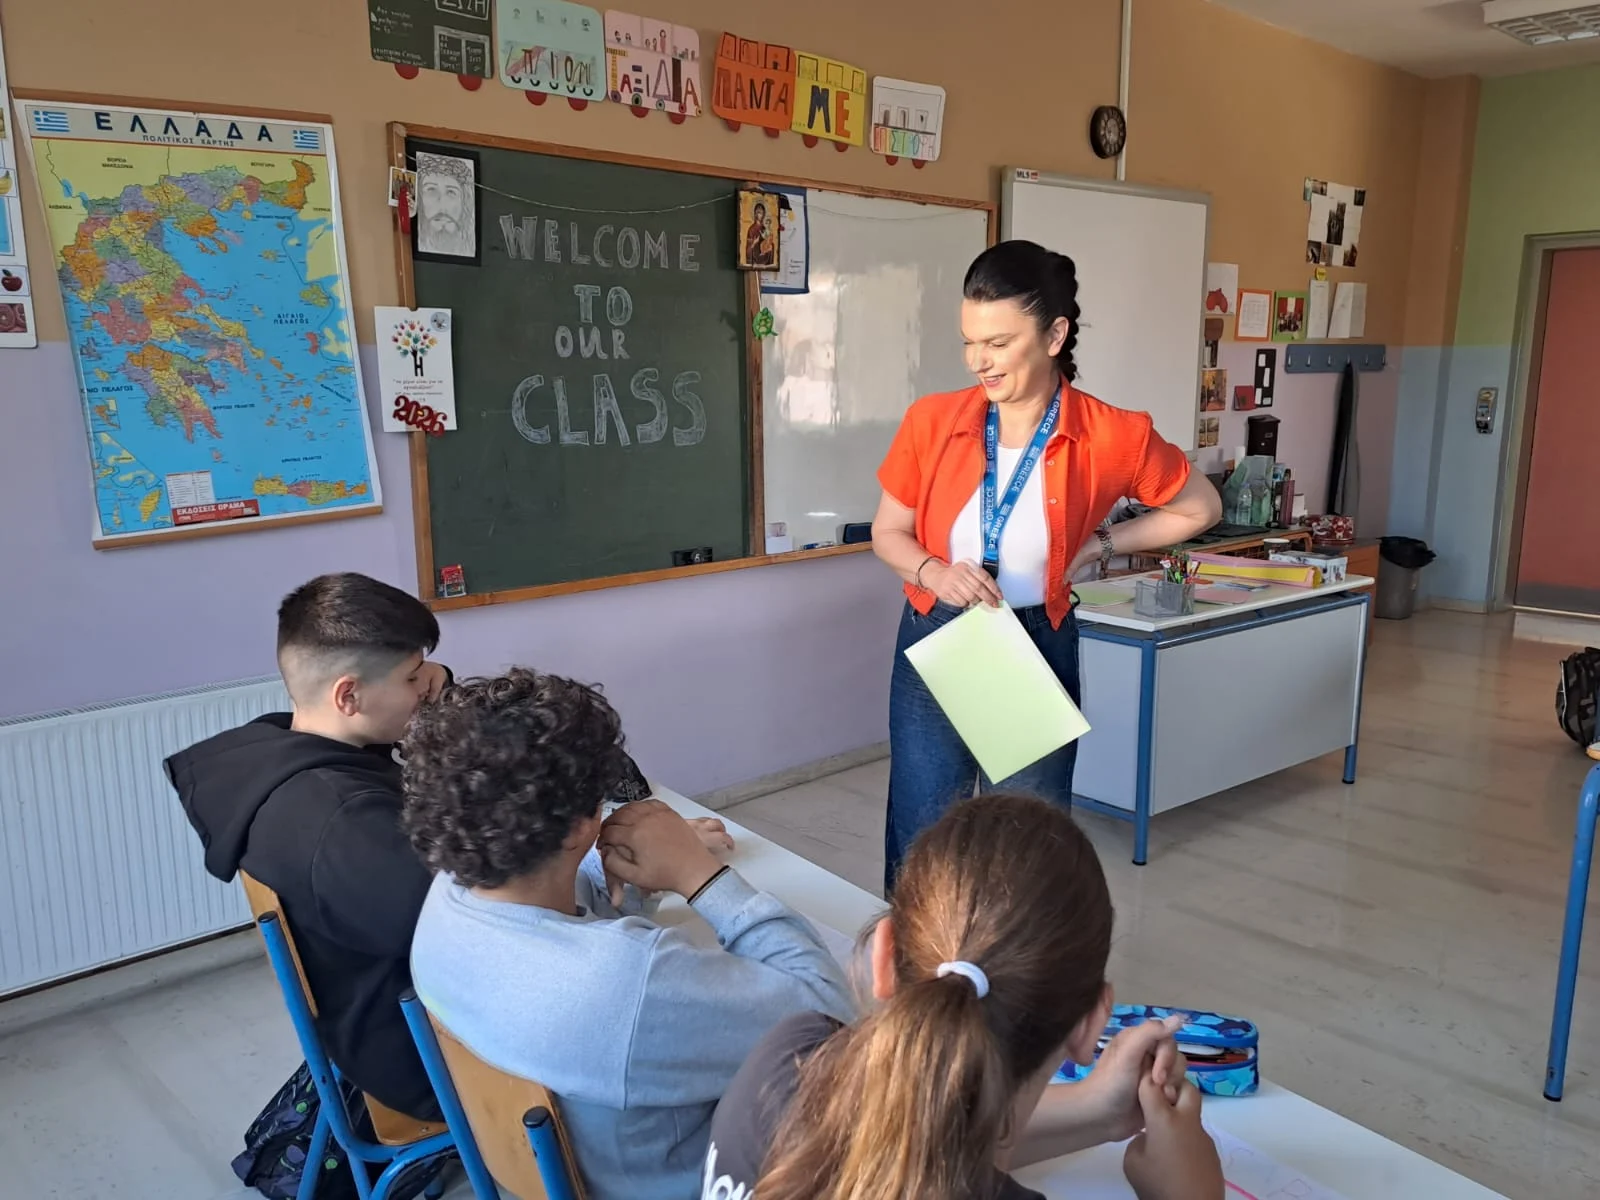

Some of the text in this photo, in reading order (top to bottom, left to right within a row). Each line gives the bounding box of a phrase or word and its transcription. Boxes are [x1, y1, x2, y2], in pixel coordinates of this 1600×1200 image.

[95, 112, 273, 143] ΕΛΛΑΔΑ
[143, 134, 194, 145] ΠΟΛΙΤΙΚΟΣ
[499, 213, 701, 272] WELCOME
[572, 283, 633, 327] TO
[554, 325, 631, 360] OUR
[392, 395, 448, 437] 2026
[511, 367, 708, 448] CLASS
[1040, 400, 1060, 435] GREECE
[986, 424, 995, 460] GREECE
[1011, 459, 1033, 492] GREECE
[176, 504, 217, 516] ΕΚΔΟΣΕΙΣ
[986, 486, 995, 521] GREECE
